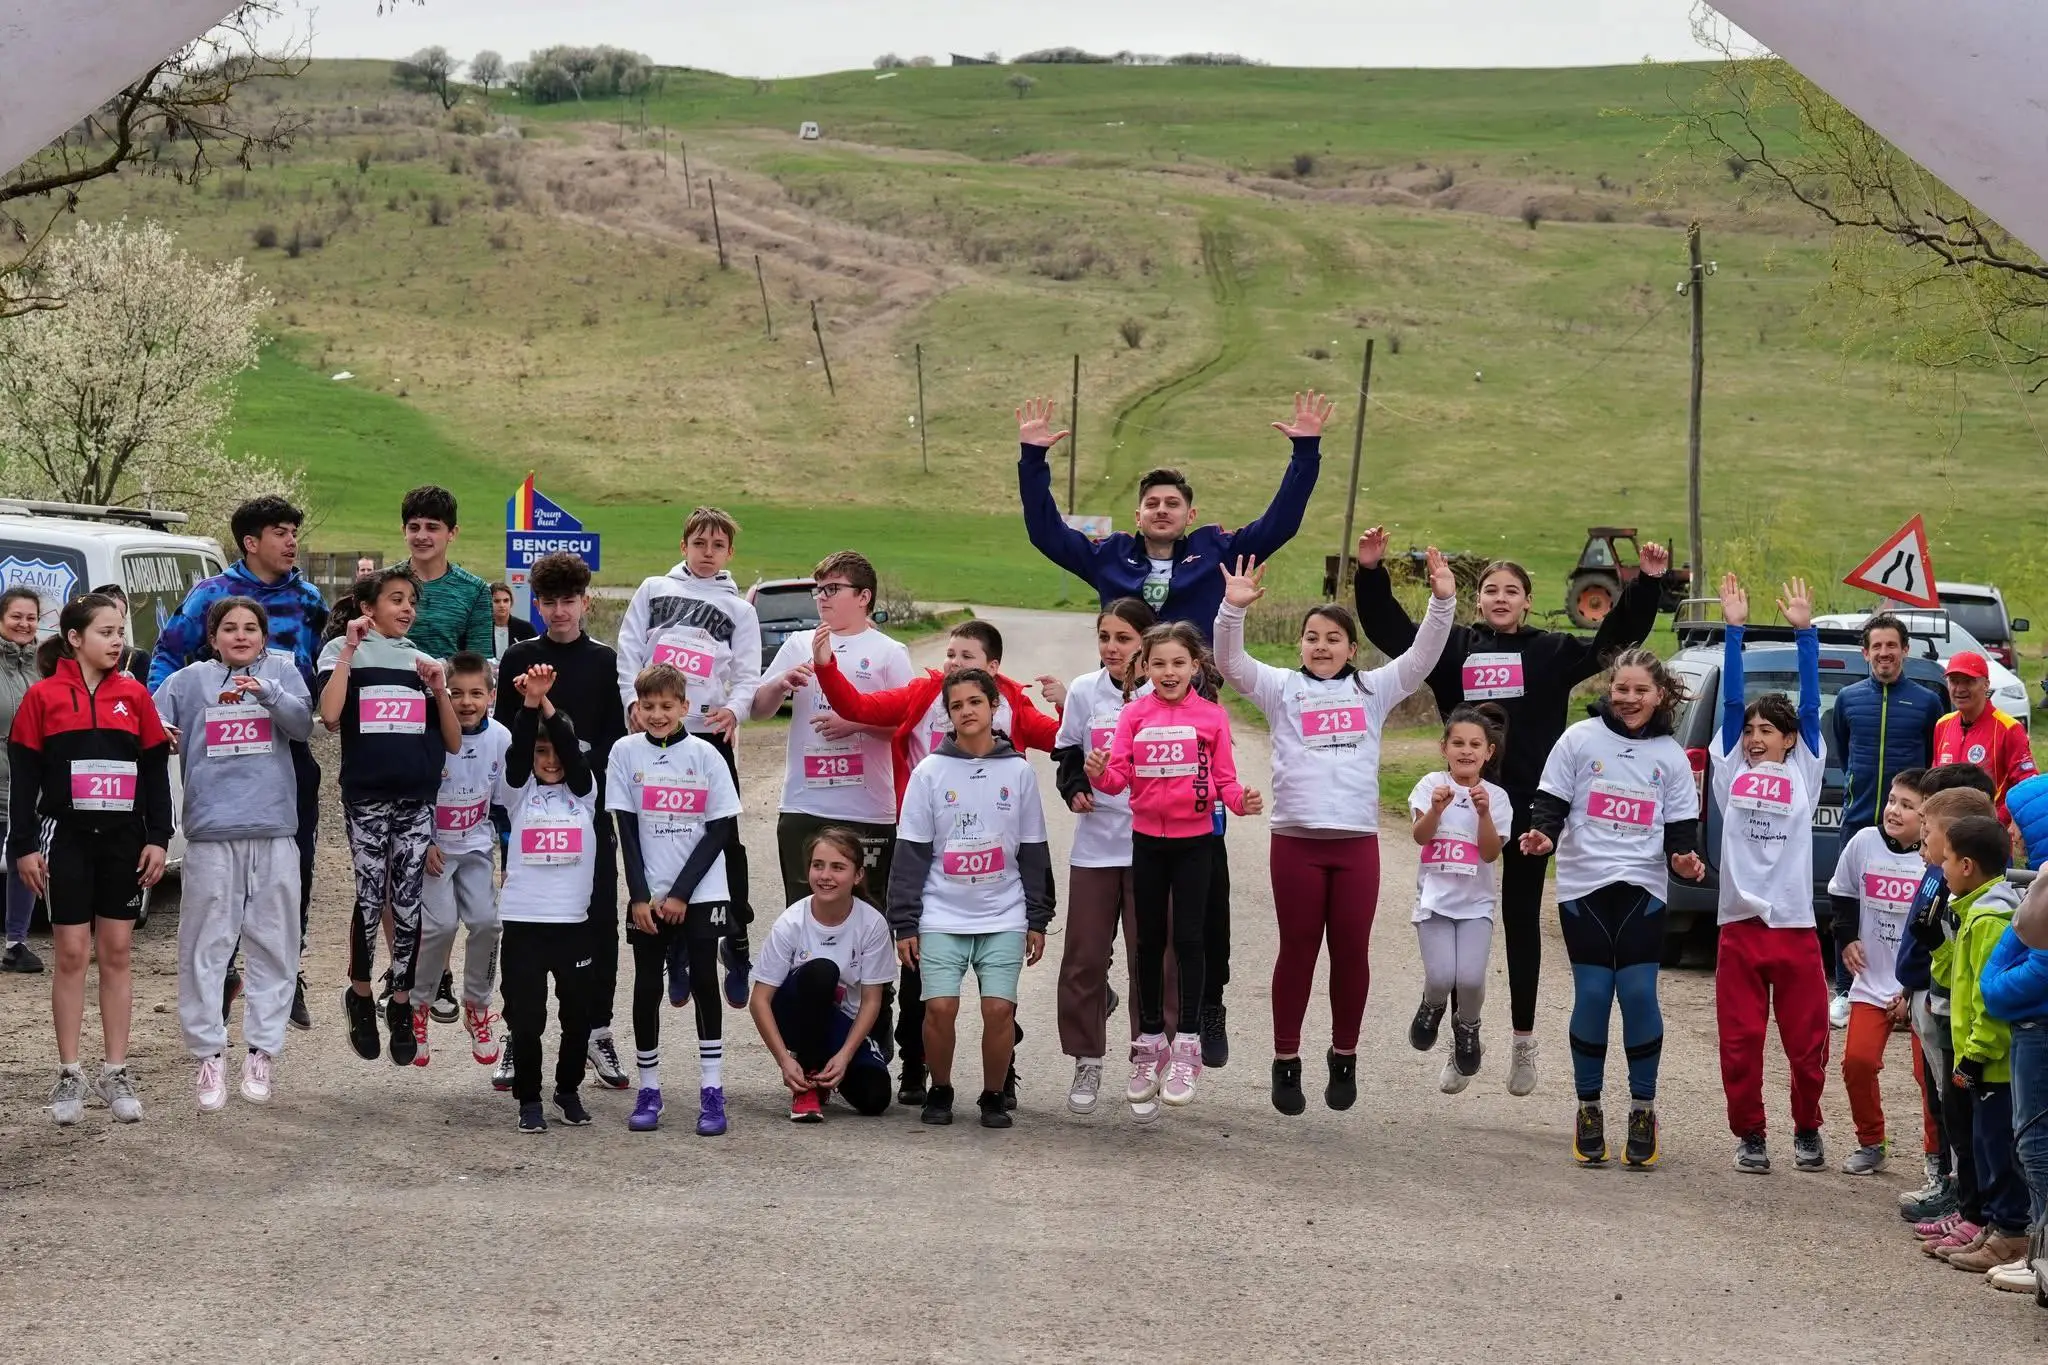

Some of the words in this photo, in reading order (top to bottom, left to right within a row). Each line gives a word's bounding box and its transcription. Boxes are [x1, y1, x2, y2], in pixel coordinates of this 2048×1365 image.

[534, 508, 562, 518] Drum
[513, 538, 592, 552] BENCECU
[1143, 585, 1169, 600] 30
[663, 648, 701, 672] 206
[1473, 667, 1510, 686] 229
[375, 701, 412, 719] 227
[1317, 711, 1352, 731] 213
[219, 721, 258, 742] 226
[1145, 743, 1184, 763] 228
[816, 758, 849, 775] 218
[1192, 736, 1208, 814] adidas
[89, 776, 121, 796] 211
[1745, 776, 1781, 799] 214
[655, 789, 695, 810] 202
[1601, 797, 1641, 821] 201
[449, 807, 479, 828] 219
[535, 831, 568, 850] 215
[1431, 841, 1465, 860] 216
[956, 852, 993, 873] 207
[1876, 878, 1915, 900] 209
[710, 906, 726, 926] 44
